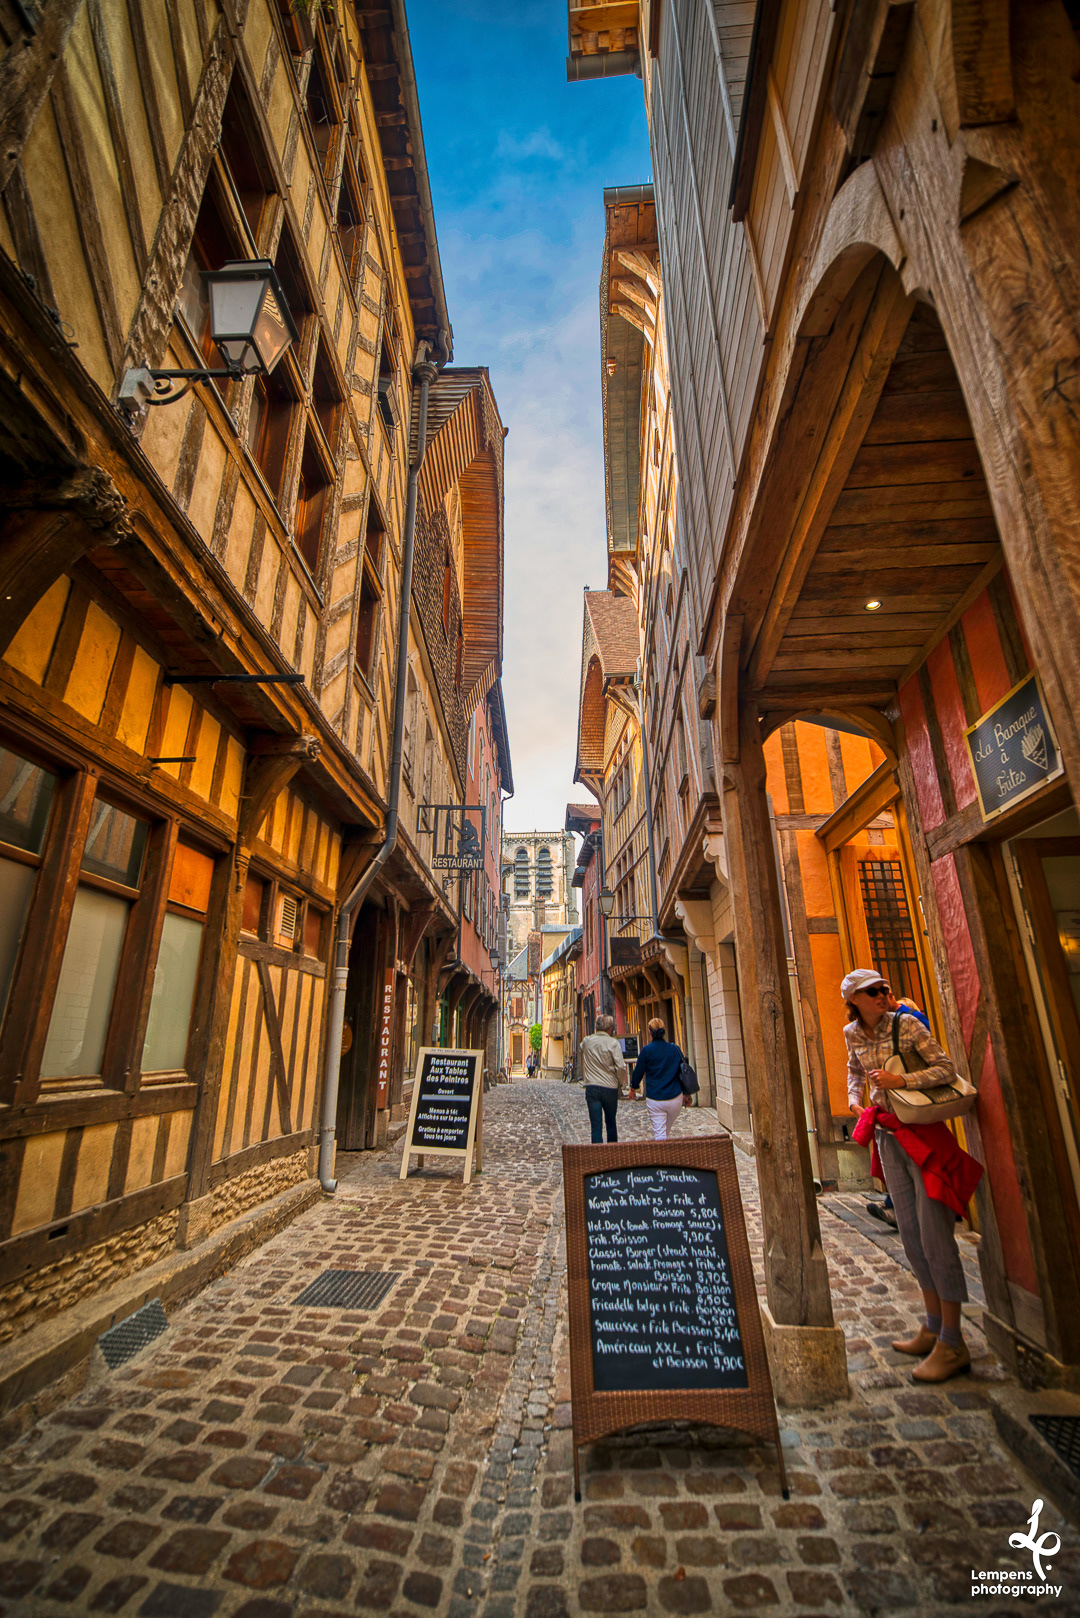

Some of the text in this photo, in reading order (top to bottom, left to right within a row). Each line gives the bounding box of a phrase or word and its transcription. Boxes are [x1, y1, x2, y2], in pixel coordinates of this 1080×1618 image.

[975, 706, 1037, 762] La Baraque
[1001, 749, 1009, 763] à
[996, 770, 1026, 797] Frites
[433, 858, 484, 868] RESTAURANT
[379, 985, 392, 1090] RESTAURANT
[431, 1057, 468, 1067] Restaurant
[430, 1066, 467, 1075] Aux Tables
[426, 1074, 468, 1084] des Peintres
[627, 1171, 654, 1188] Maison
[588, 1195, 618, 1213] Nuggets
[619, 1196, 628, 1206] de
[629, 1194, 650, 1206] Poulet
[653, 1207, 719, 1220] Boisson 5,80€
[612, 1235, 648, 1244] Boisson
[682, 1231, 713, 1244] 7,90€
[589, 1248, 622, 1258] Classic
[626, 1246, 655, 1260] Burger
[654, 1259, 686, 1273] Fromage
[654, 1271, 692, 1282] Boisson
[592, 1278, 620, 1295] Croque
[695, 1282, 731, 1294] Boisson
[592, 1298, 634, 1312] Fricadelle
[637, 1298, 660, 1317] belge
[696, 1302, 735, 1316] Boisson
[595, 1318, 639, 1333] Saucisse
[672, 1320, 713, 1338] Boisson
[597, 1338, 652, 1354] Américain
[655, 1342, 681, 1355] XXL
[652, 1355, 744, 1373] et Boisson 9,90€
